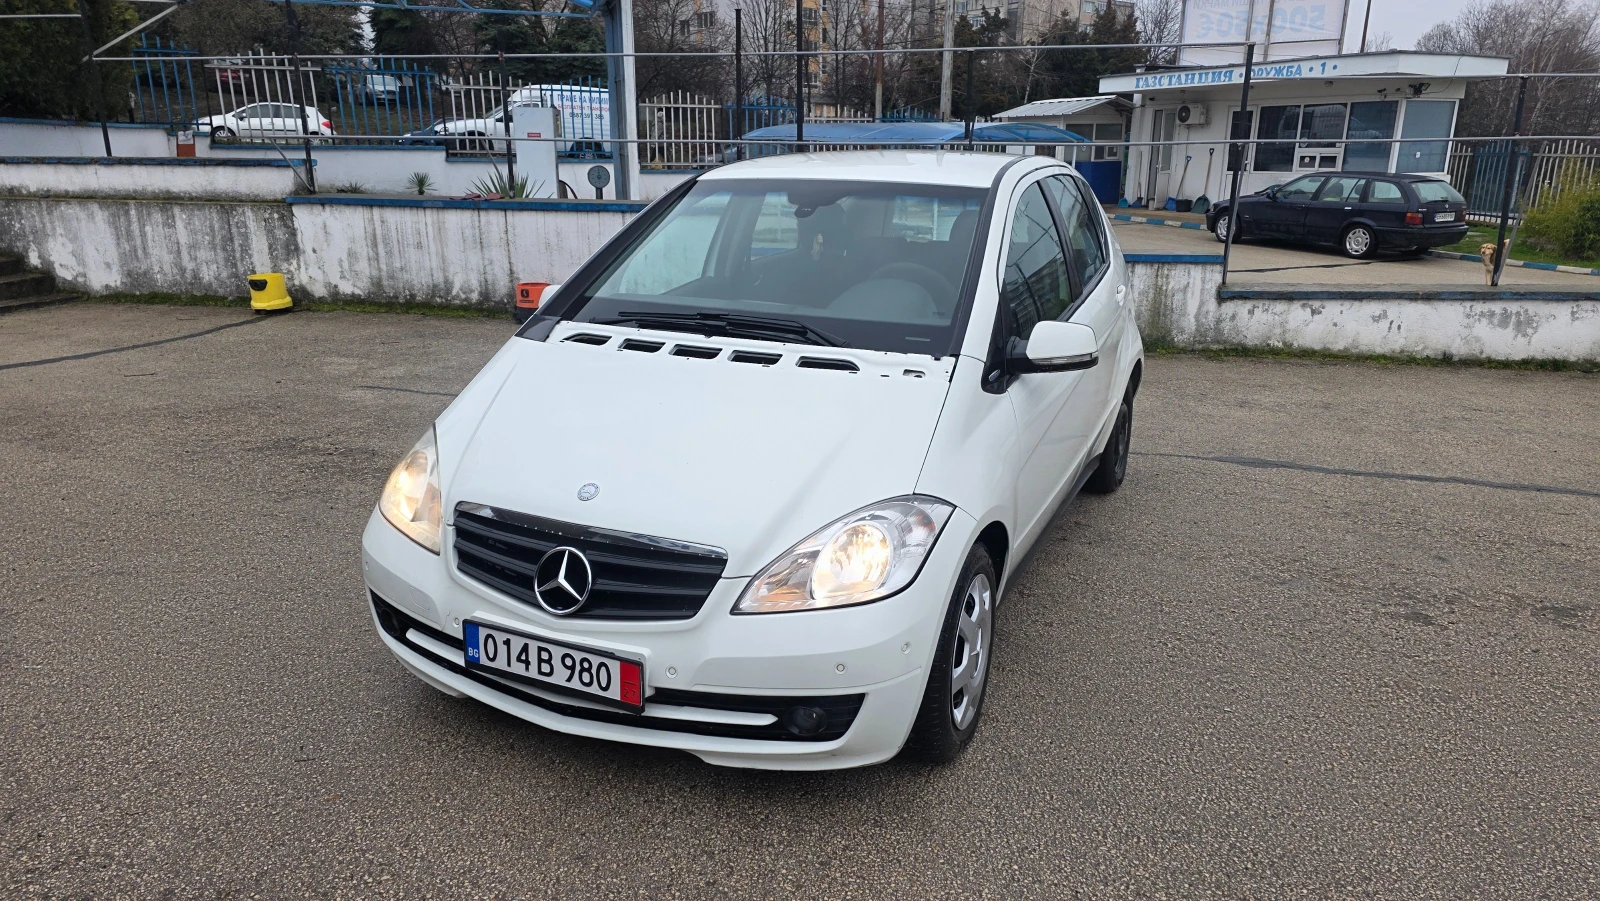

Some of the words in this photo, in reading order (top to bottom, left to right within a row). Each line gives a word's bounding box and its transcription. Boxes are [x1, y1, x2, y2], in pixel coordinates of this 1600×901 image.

[1135, 69, 1235, 89] ГАЗСТАНЦИЯ
[1320, 61, 1326, 75] 1
[468, 647, 479, 658] BG
[623, 688, 637, 699] 27
